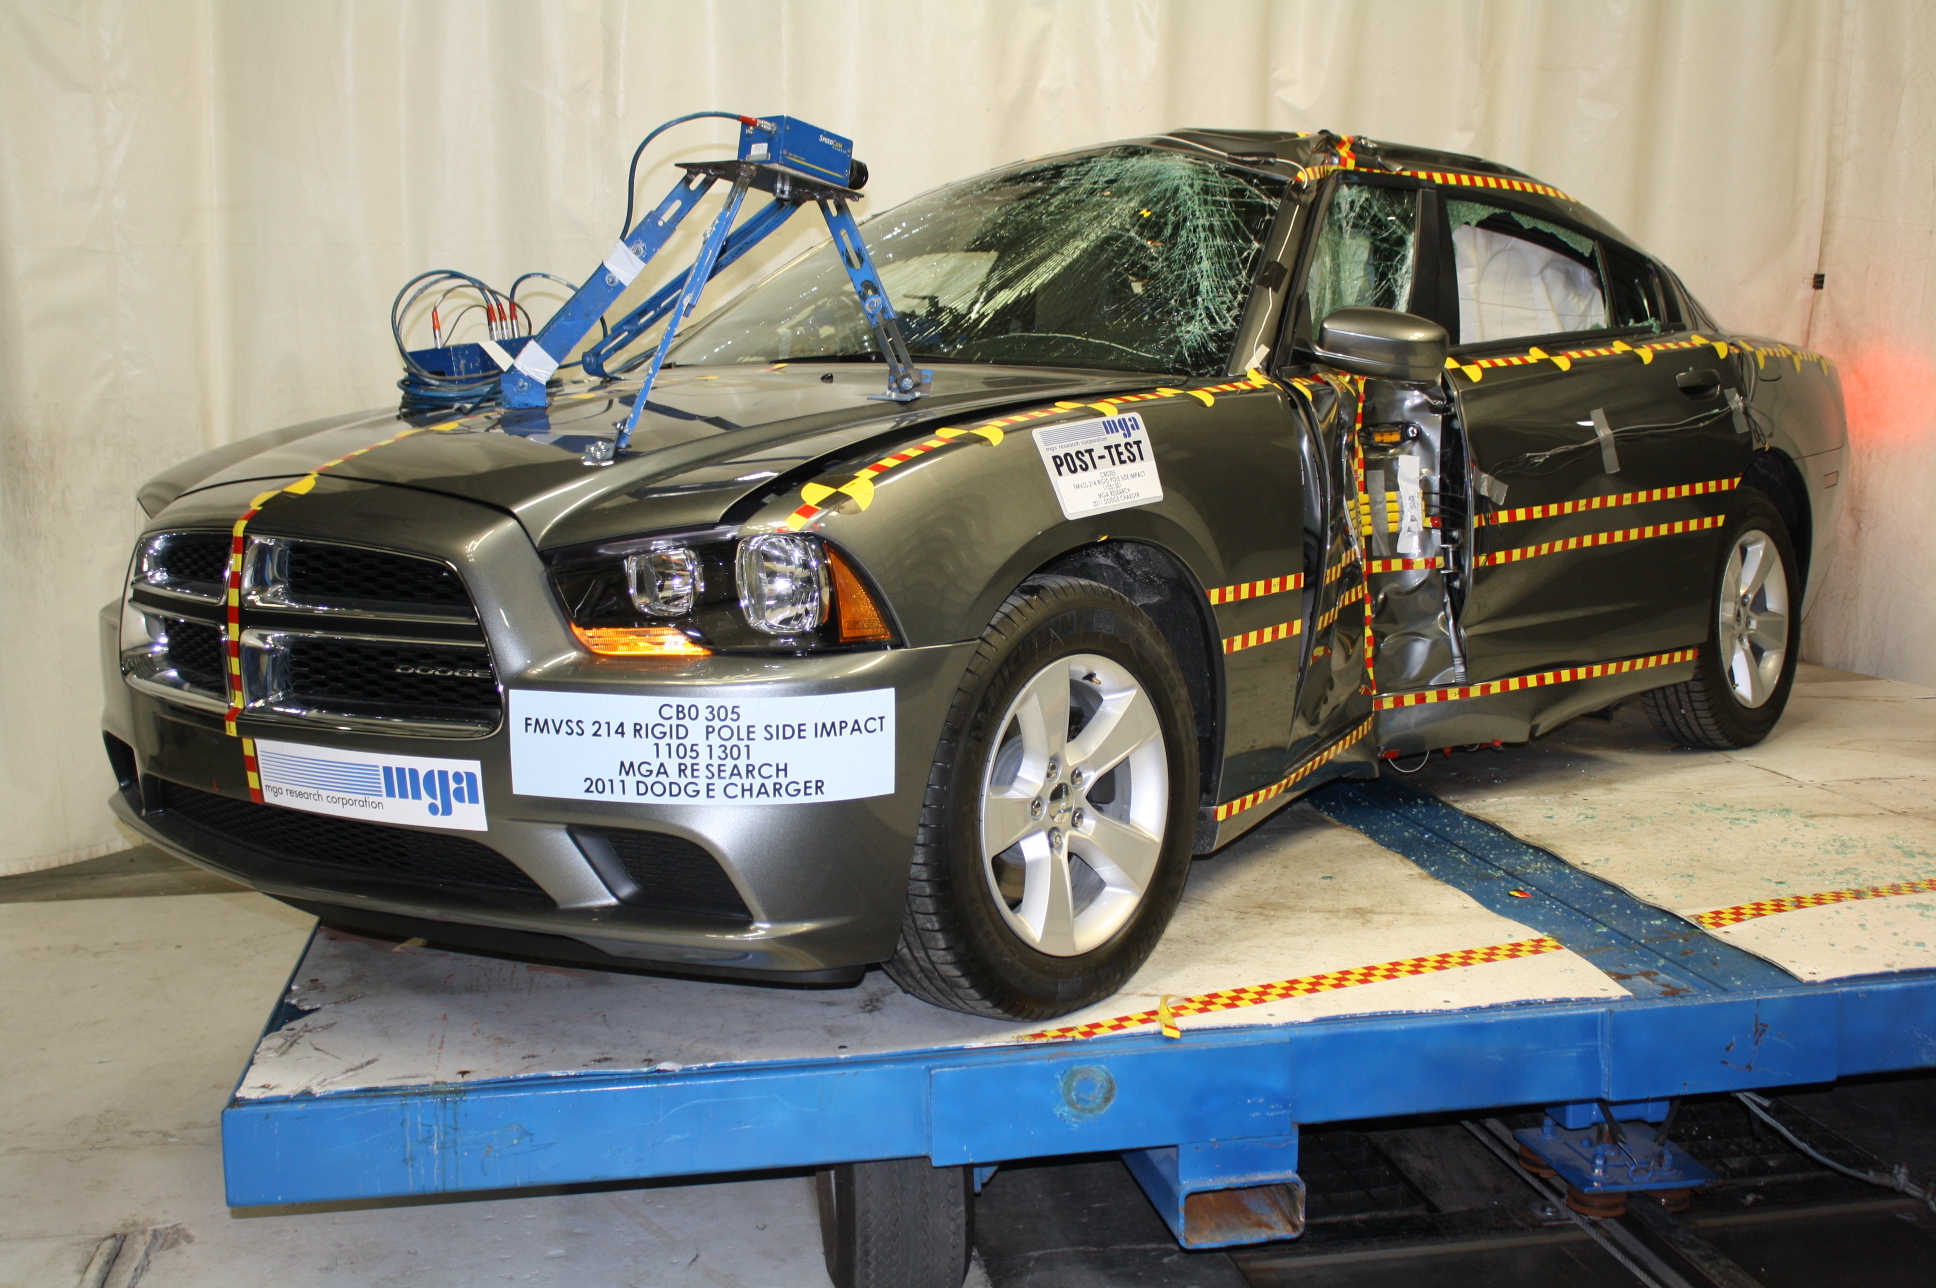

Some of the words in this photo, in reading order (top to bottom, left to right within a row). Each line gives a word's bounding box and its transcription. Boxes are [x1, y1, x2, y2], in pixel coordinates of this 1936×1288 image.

[1101, 416, 1140, 439] mga
[1051, 440, 1145, 477] POST-TEST
[395, 664, 492, 679] DODGE
[524, 717, 585, 737] FMVSS
[591, 720, 626, 738] 214
[633, 722, 689, 740] RIGID
[705, 724, 756, 741] POLE
[763, 723, 807, 741] SIDE
[814, 715, 885, 739] IMPACT
[618, 760, 669, 778] MGA
[264, 783, 284, 798] mga
[285, 786, 324, 803] research
[326, 794, 384, 810] corporation
[382, 765, 480, 817] mga
[583, 777, 626, 795] 2011
[723, 779, 825, 799] CHARGER
